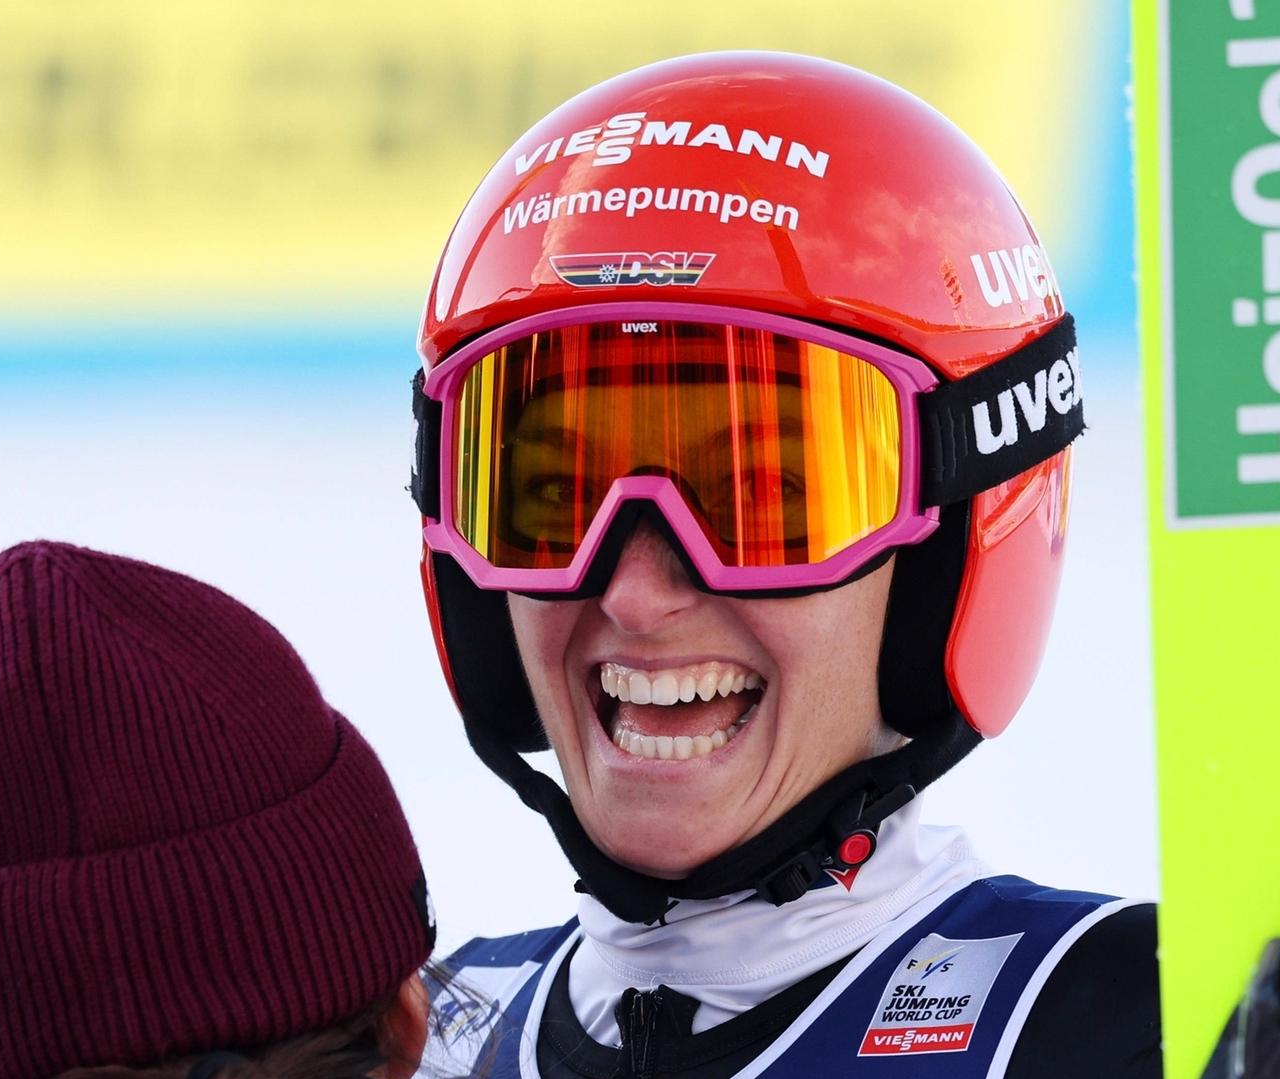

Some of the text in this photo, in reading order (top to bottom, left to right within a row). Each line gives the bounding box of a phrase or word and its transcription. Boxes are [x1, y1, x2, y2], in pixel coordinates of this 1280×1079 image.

[515, 111, 830, 178] VIESSMANN
[503, 186, 800, 235] Wärmepumpen
[617, 252, 717, 287] DSV
[622, 322, 658, 334] uvex
[892, 985, 926, 997] SKI
[885, 995, 971, 1011] JUMPING
[881, 1009, 962, 1023] WORLD CUP
[874, 1030, 965, 1051] VIESSMANN
